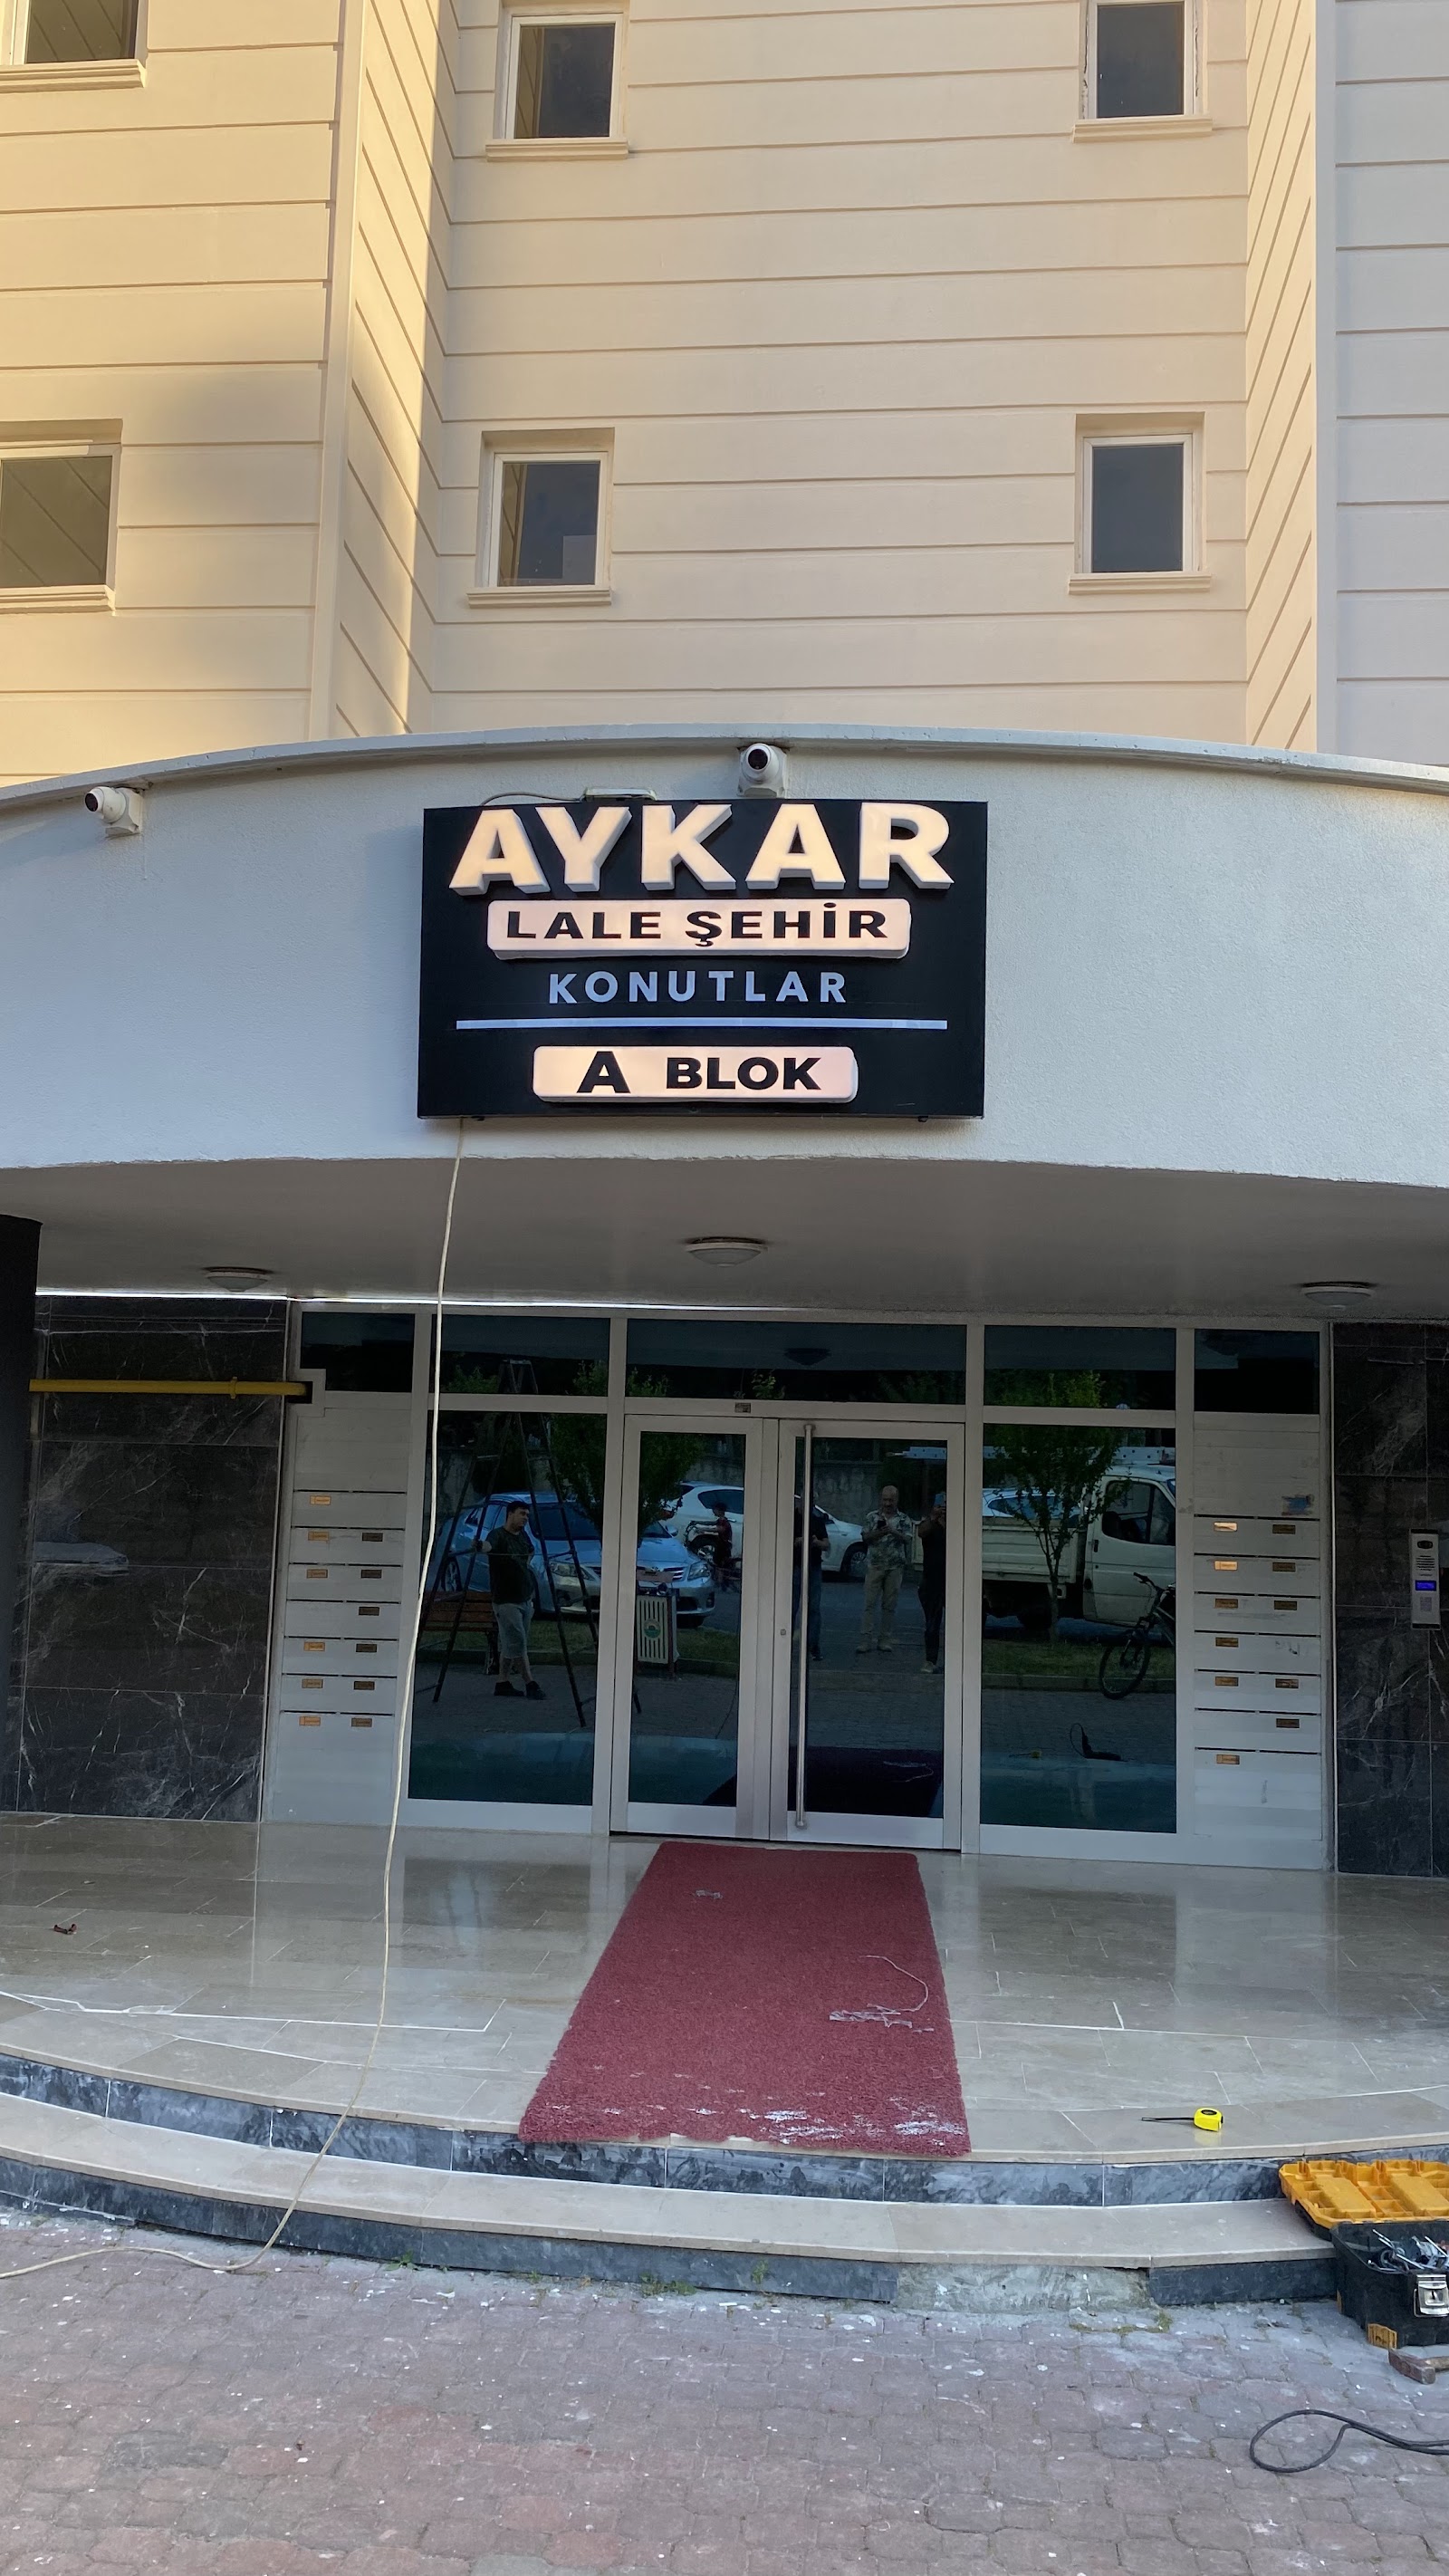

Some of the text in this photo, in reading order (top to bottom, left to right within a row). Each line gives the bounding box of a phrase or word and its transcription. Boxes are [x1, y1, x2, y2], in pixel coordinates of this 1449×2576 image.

[449, 803, 955, 893] AYKAR
[506, 902, 888, 947] LALE ŞEHİR
[549, 970, 847, 1004] KONUTLAR
[576, 1051, 821, 1094] A BLOK
